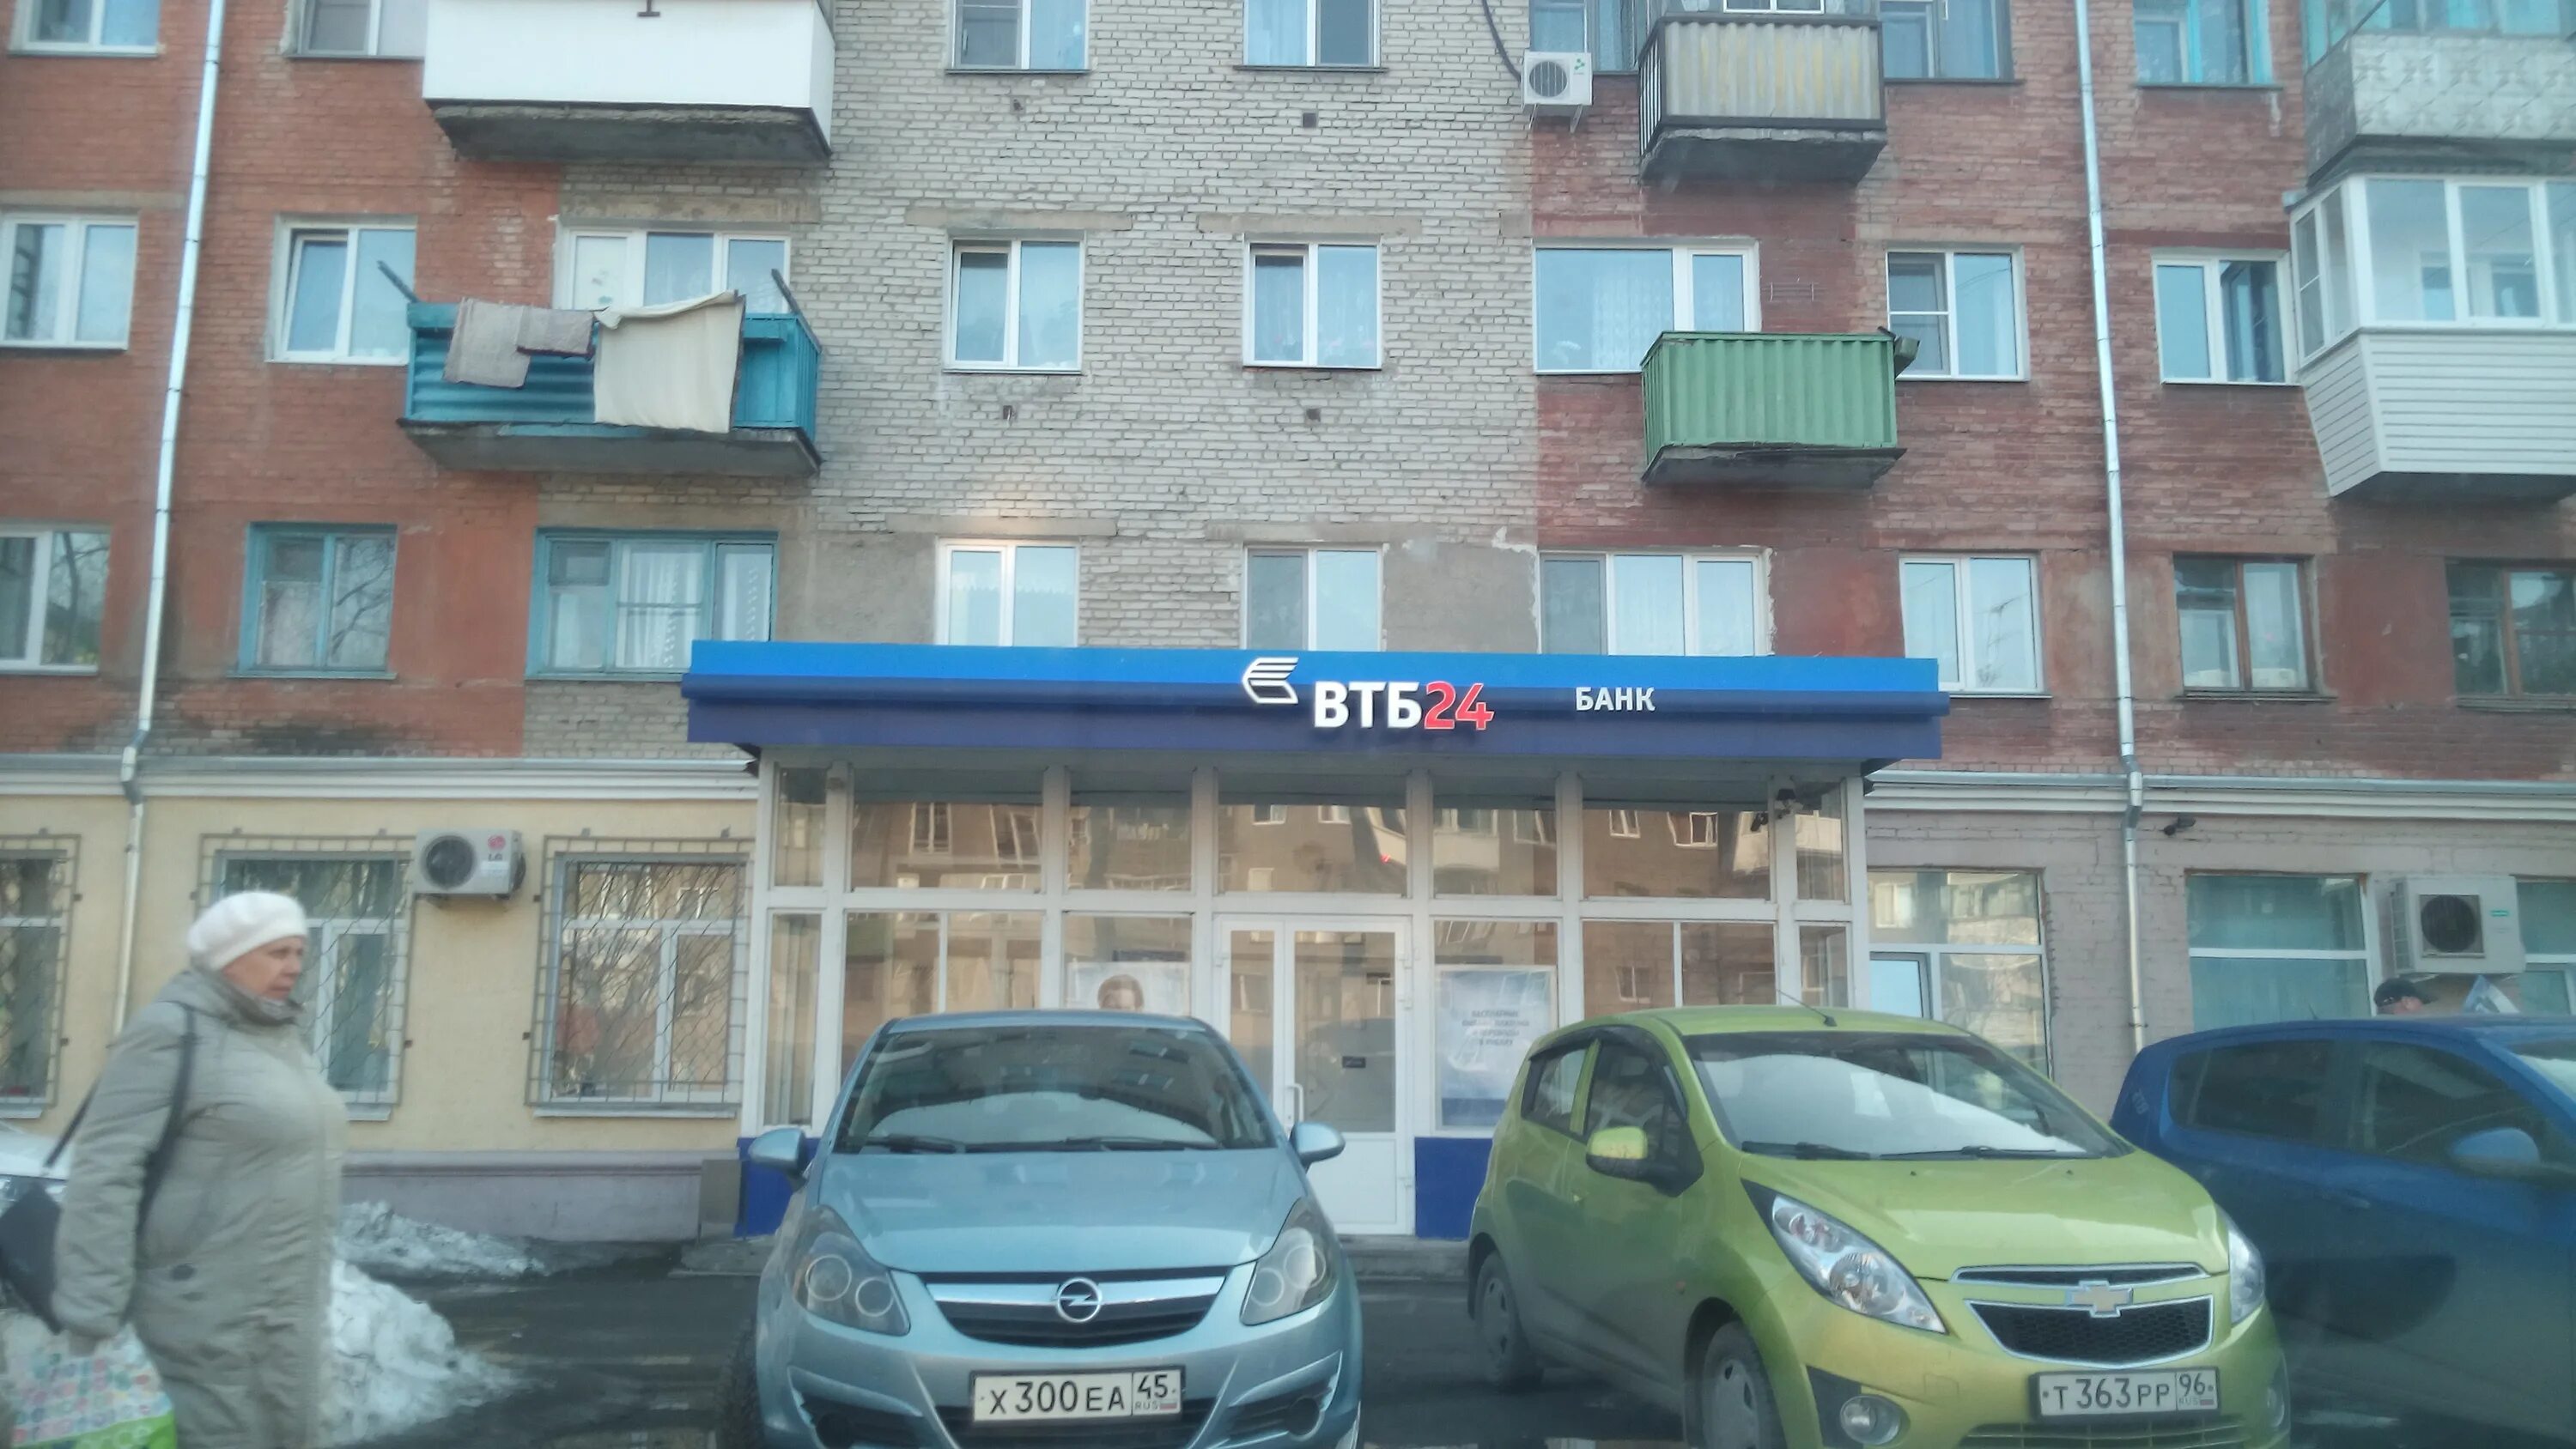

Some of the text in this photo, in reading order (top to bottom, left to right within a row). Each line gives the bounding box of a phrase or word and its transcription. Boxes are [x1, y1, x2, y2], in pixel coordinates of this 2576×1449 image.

[1314, 681, 1656, 731] ВТБ24 БАНК
[1137, 1374, 1169, 1400] 45
[2178, 1373, 2206, 1397] 96
[1134, 1400, 1159, 1410] RUS
